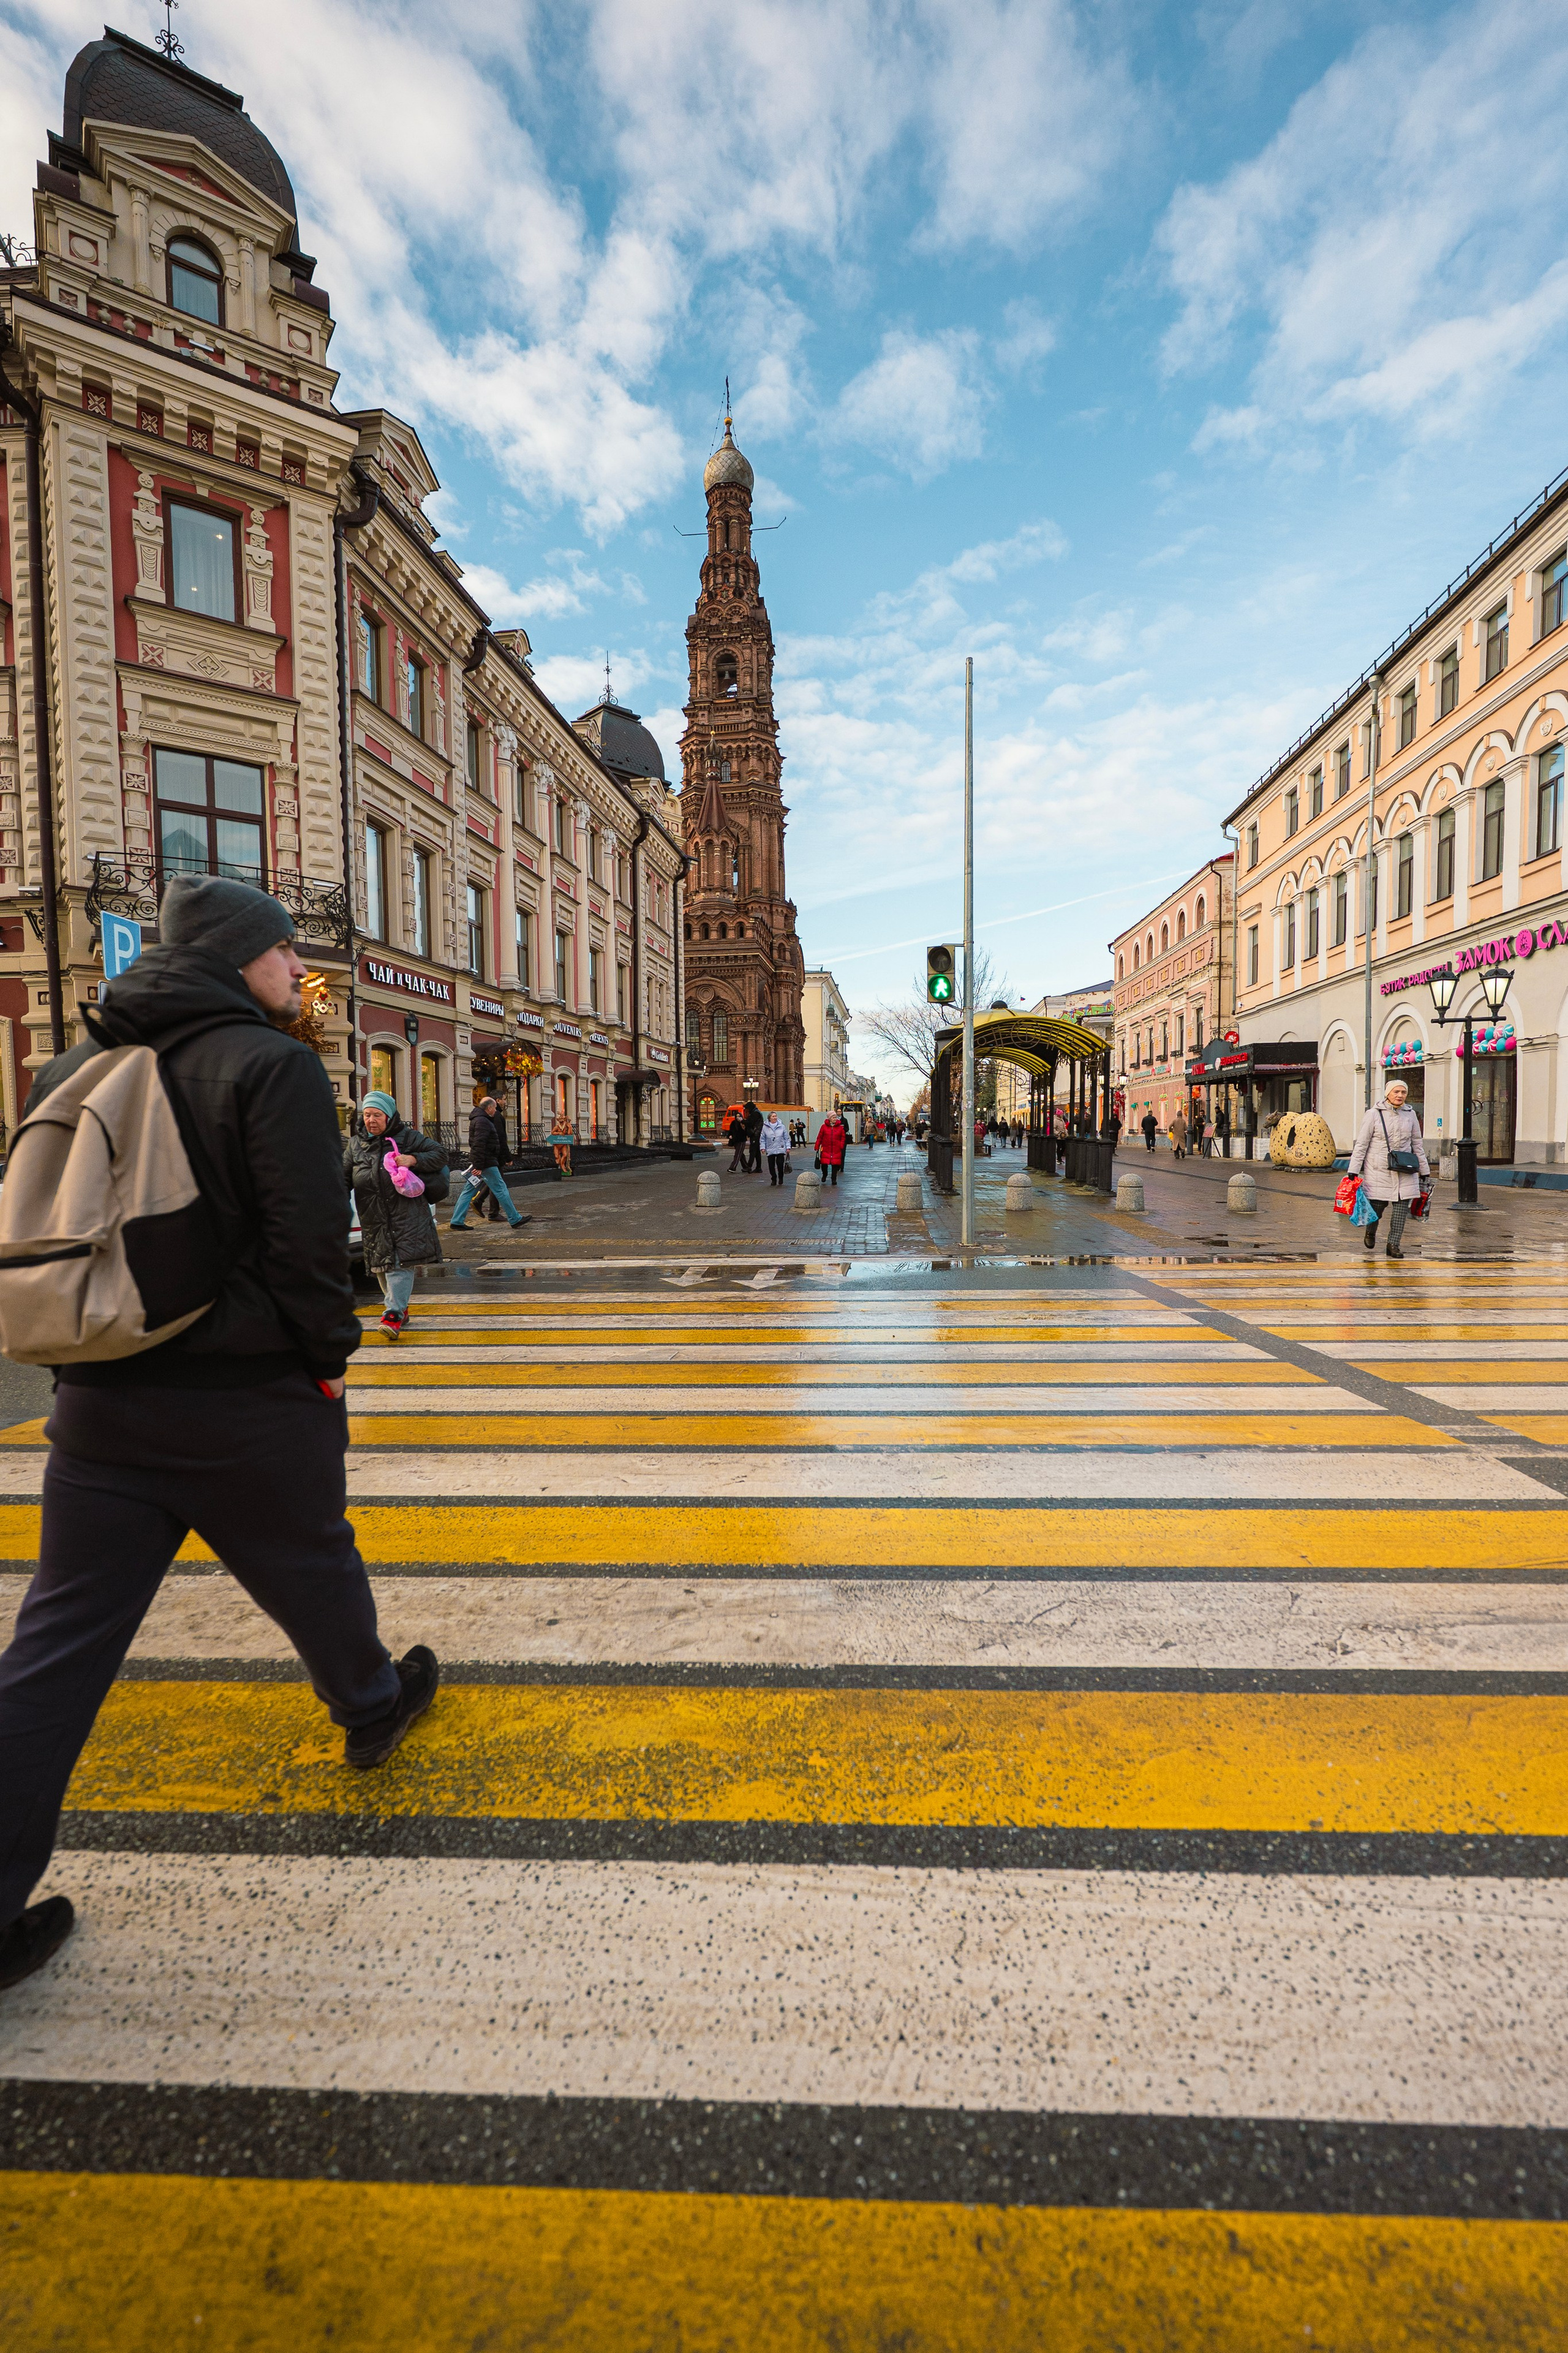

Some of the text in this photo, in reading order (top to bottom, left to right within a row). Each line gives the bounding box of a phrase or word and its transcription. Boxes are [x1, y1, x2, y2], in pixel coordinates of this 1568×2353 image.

[113, 923, 134, 975] P
[1454, 935, 1512, 973] ЗАМОК
[368, 961, 394, 985] ЧАЙ
[1379, 977, 1406, 995] БУТИК
